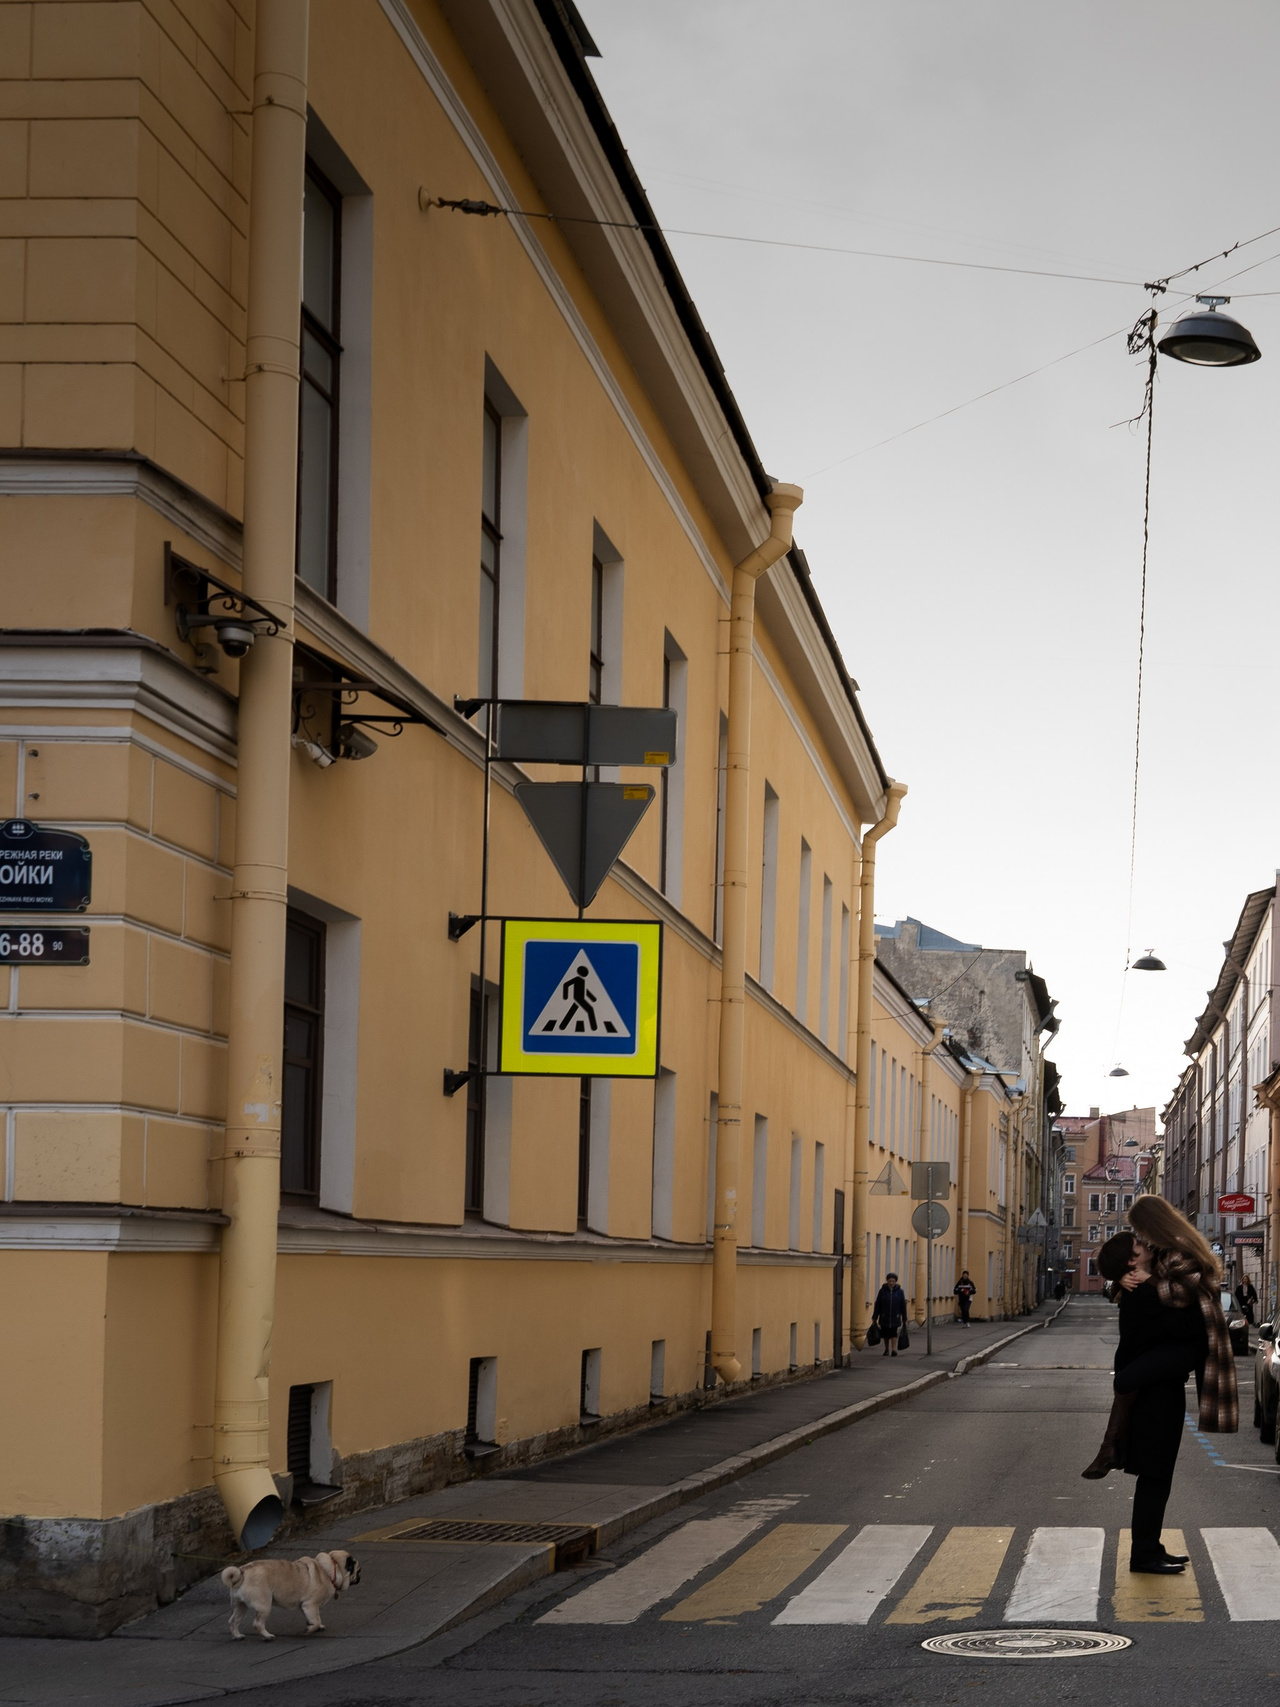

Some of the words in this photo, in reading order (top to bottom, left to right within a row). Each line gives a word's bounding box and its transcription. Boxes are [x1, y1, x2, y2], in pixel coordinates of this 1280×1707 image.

[39, 850, 63, 860] РЕКИ
[0, 860, 54, 885] ОЙКИ
[0, 932, 44, 956] 6-88
[52, 941, 63, 951] 90
